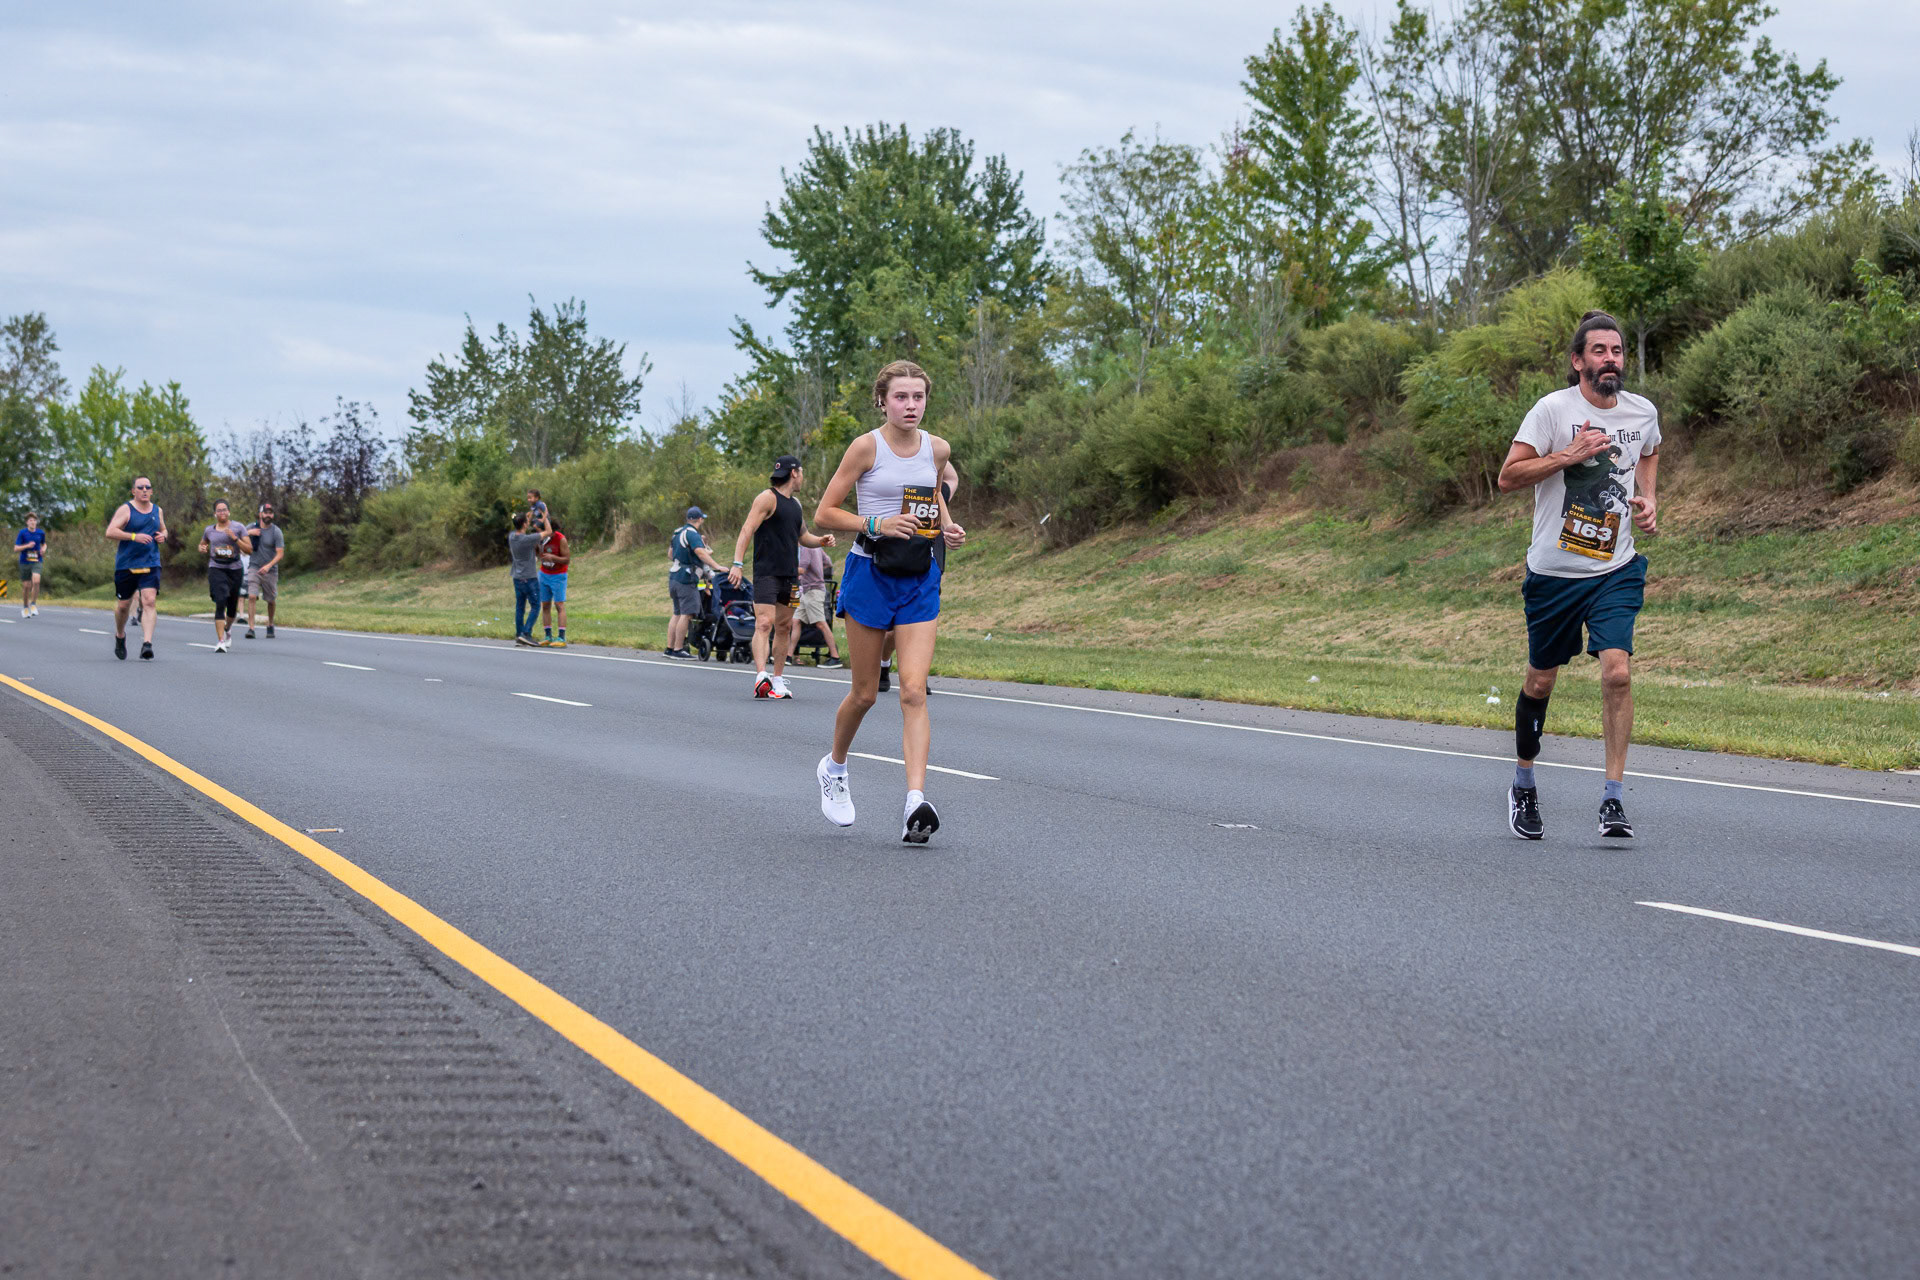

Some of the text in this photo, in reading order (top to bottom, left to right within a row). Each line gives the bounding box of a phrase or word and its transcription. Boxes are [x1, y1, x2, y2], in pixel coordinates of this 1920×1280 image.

[1617, 429, 1642, 444] Titan
[909, 502, 939, 519] 165
[1571, 503, 1585, 513] THE
[1568, 510, 1593, 522] CHASE
[1572, 519, 1613, 542] 163
